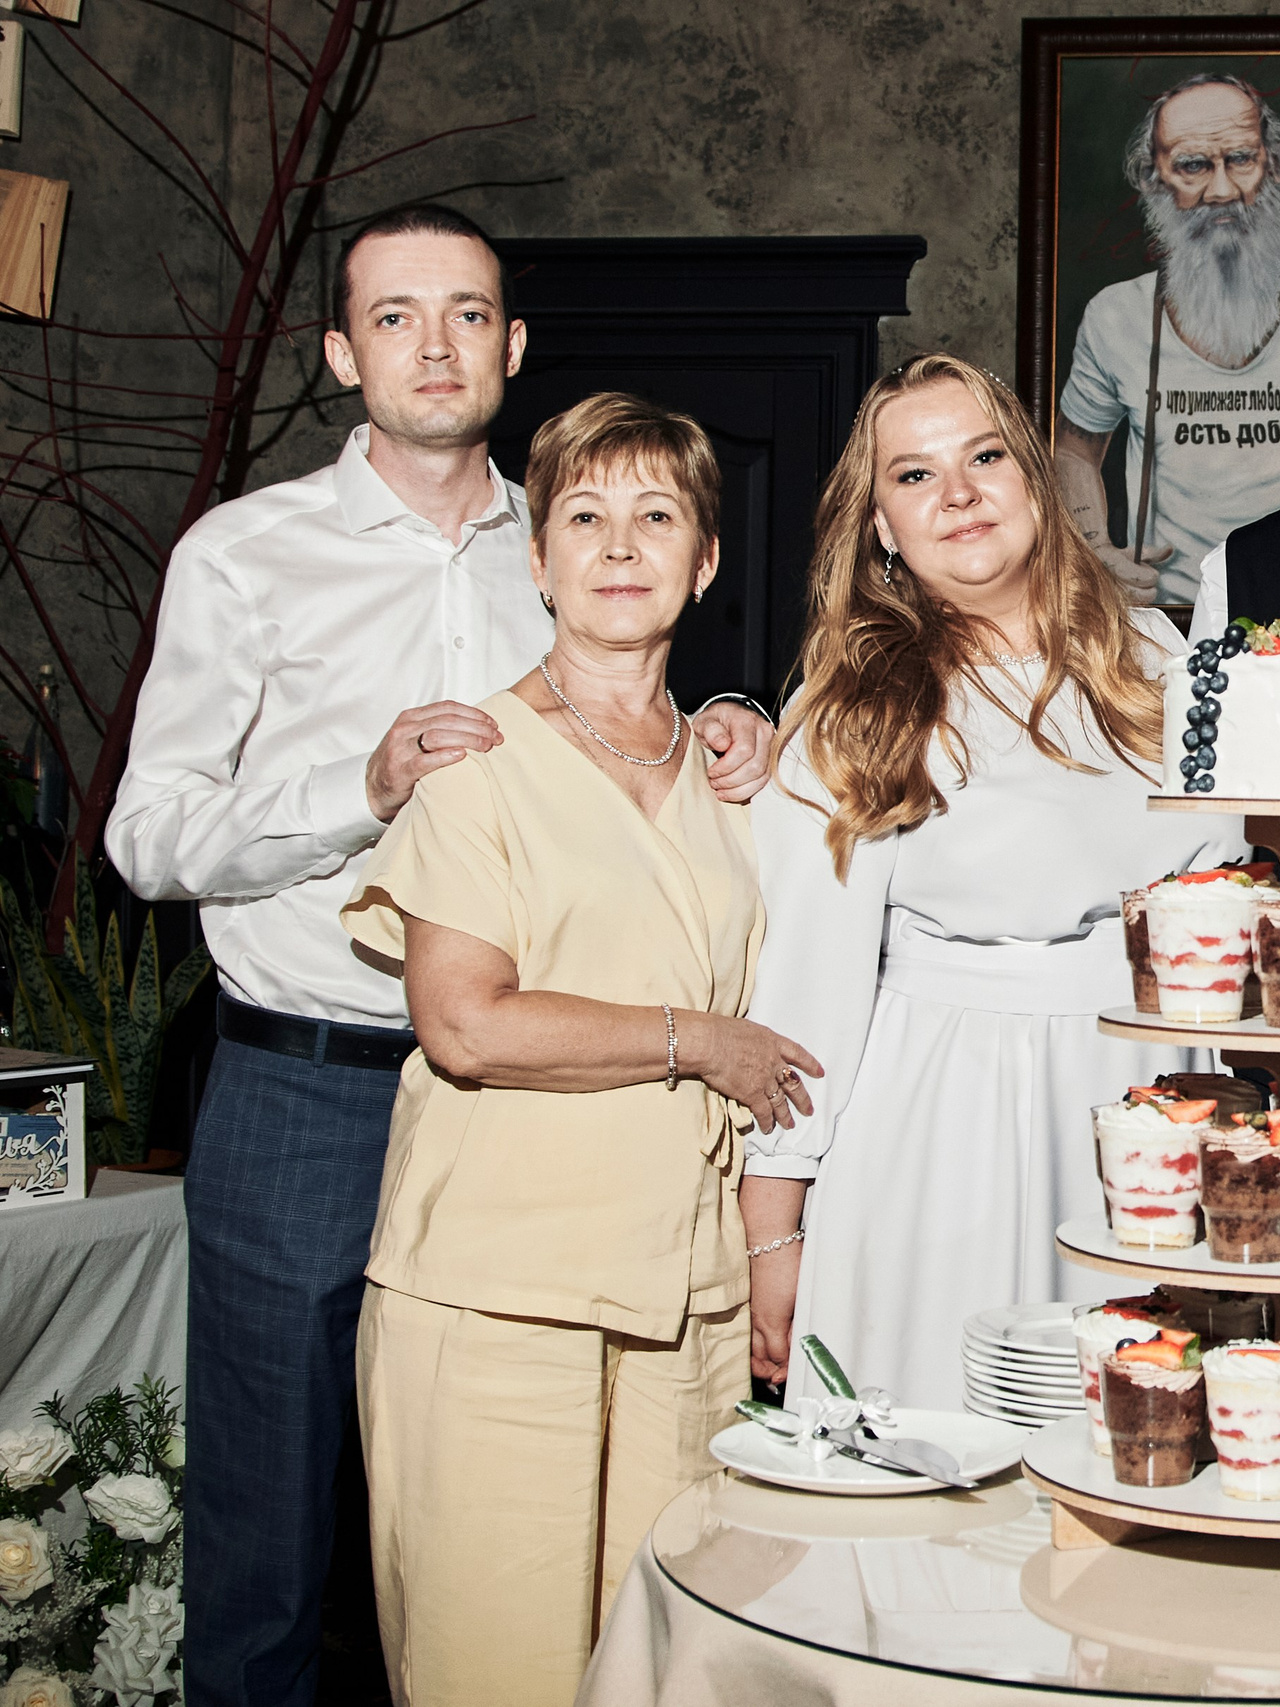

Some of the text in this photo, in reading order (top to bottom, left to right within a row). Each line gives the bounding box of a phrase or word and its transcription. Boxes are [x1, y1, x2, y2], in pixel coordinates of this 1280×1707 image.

[1165, 389, 1187, 414] что
[1187, 390, 1247, 416] умножает
[1174, 422, 1231, 445] есть
